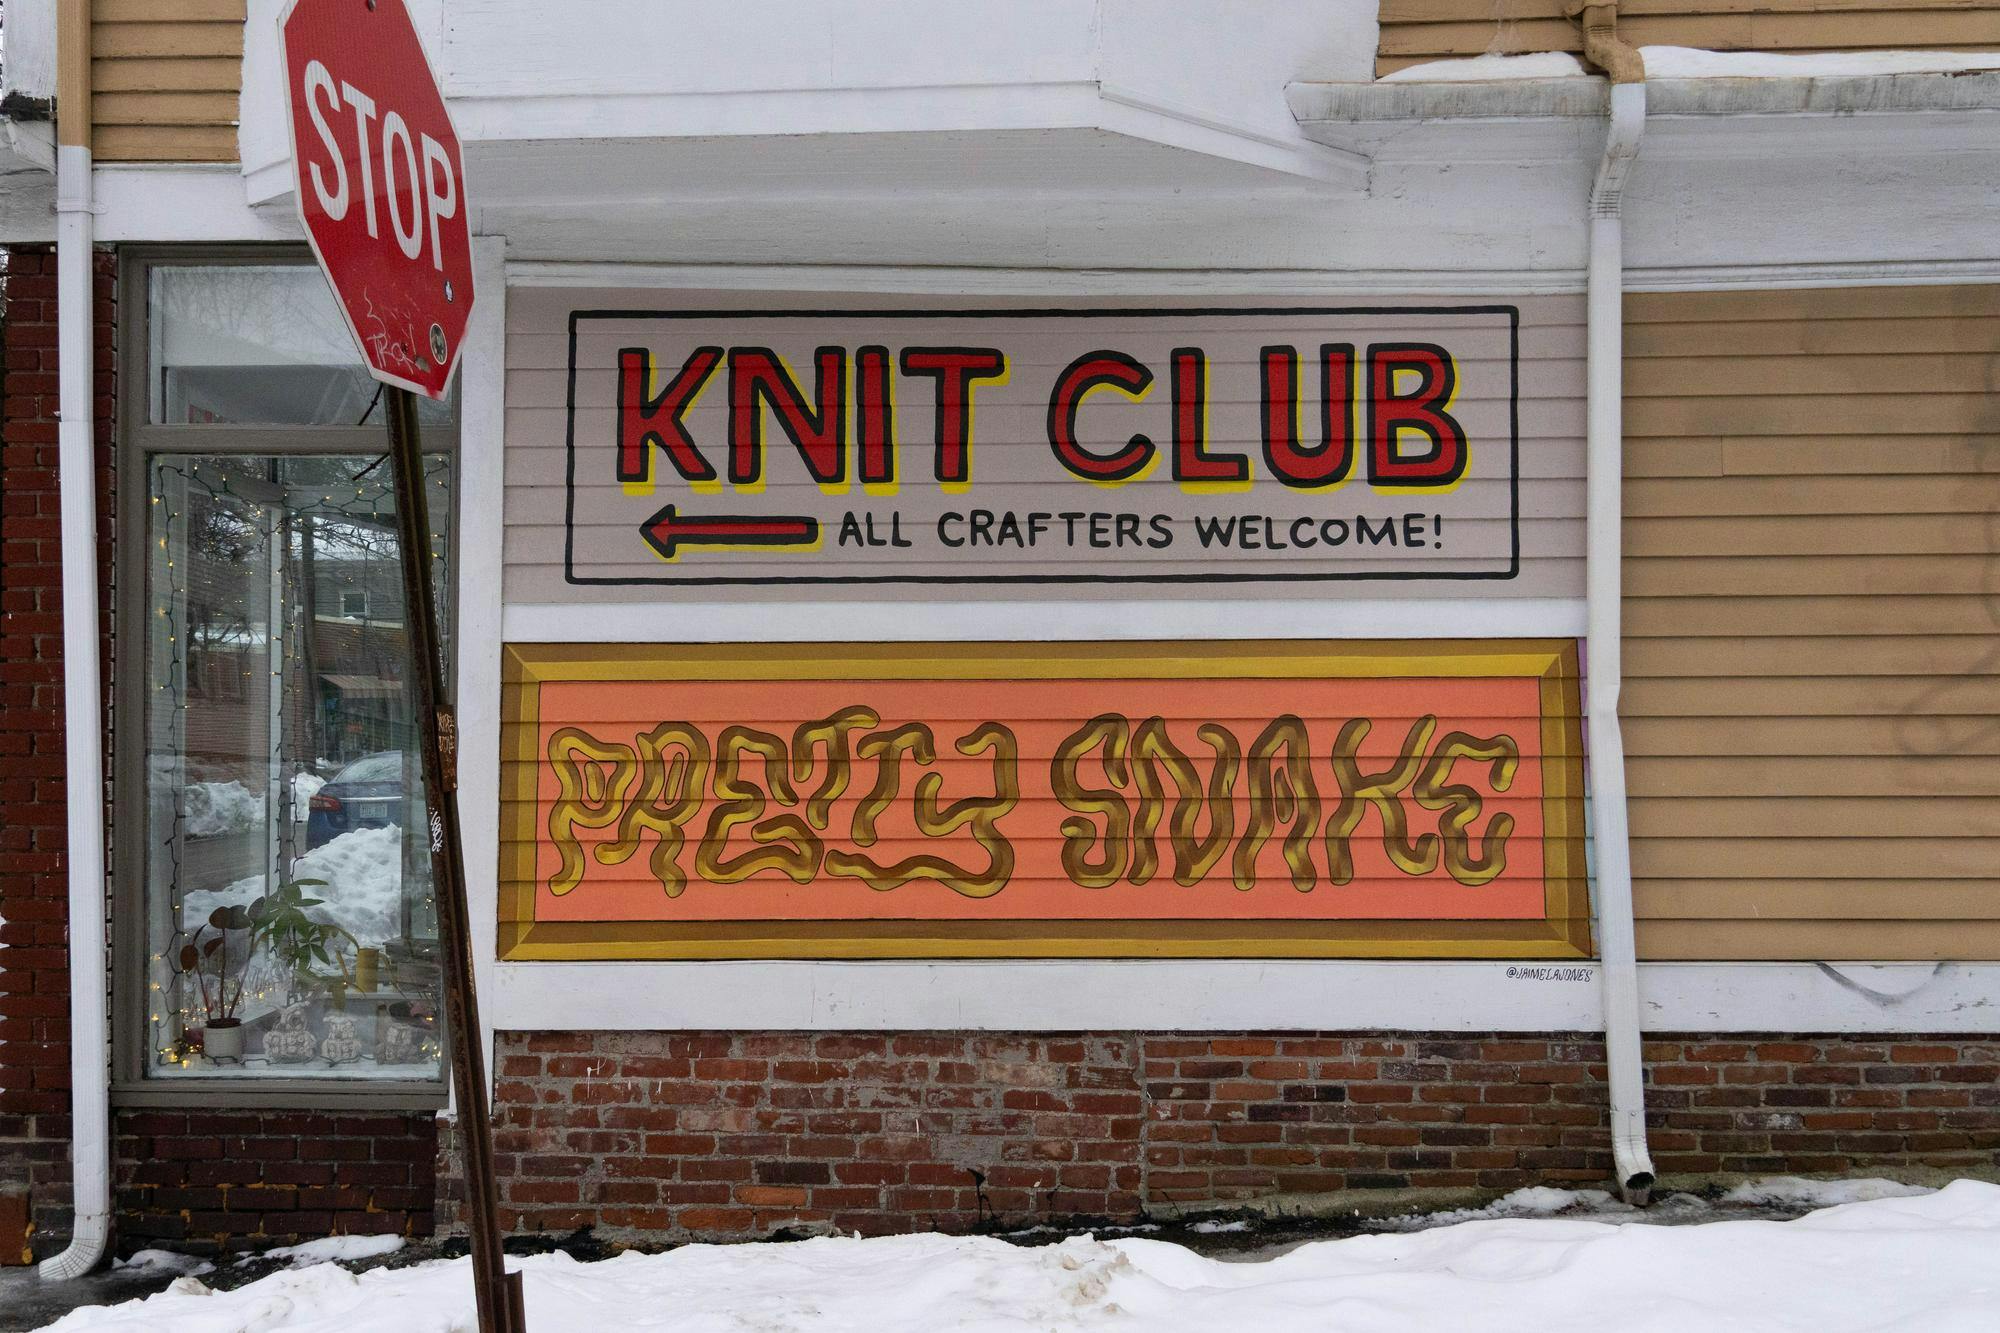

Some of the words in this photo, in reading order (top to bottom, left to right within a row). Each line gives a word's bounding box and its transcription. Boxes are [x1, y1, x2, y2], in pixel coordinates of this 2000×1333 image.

[304, 60, 456, 272] STOP
[617, 345, 1010, 495] KNIT
[1047, 343, 1472, 495] CLUB
[838, 511, 912, 548] ALL
[937, 510, 1174, 549] CRAFTERS
[1194, 513, 1442, 550] WELCOME!
[548, 705, 1019, 898] PRETTY
[1050, 713, 1518, 892] SNAKE
